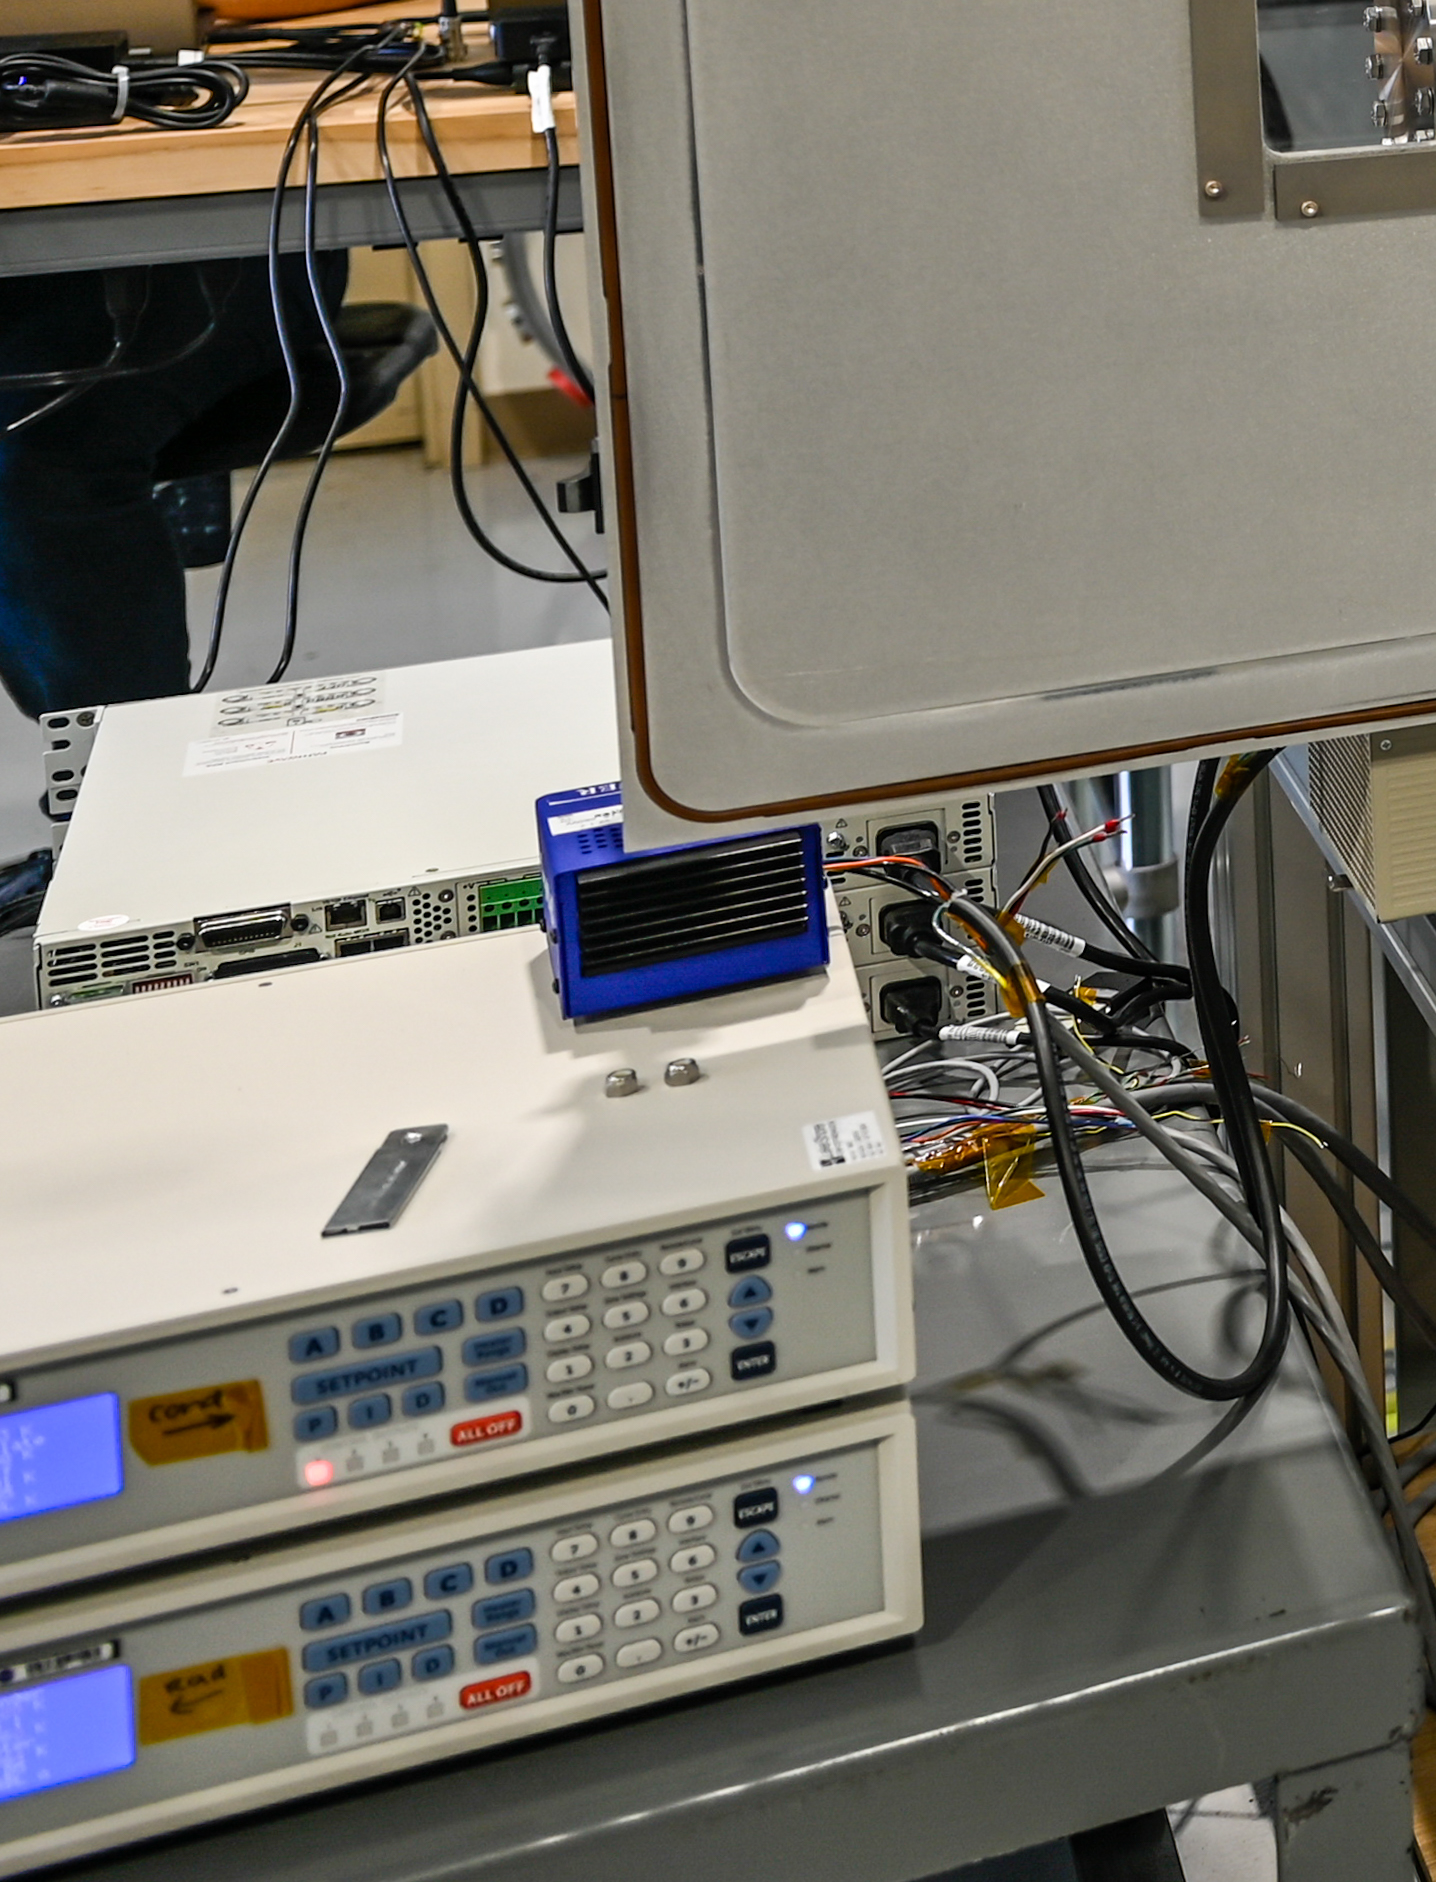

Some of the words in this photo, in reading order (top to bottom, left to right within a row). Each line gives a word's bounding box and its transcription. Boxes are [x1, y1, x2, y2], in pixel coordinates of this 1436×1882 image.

[729, 1247, 766, 1263] ESCAPE
[305, 1338, 323, 1356] A
[368, 1323, 385, 1342] B
[429, 1310, 447, 1328] C
[489, 1297, 508, 1315] D
[316, 1359, 417, 1394] SETPOINT
[737, 1355, 770, 1371] ENTER
[308, 1418, 321, 1432] P
[415, 1393, 430, 1409] D
[457, 1425, 485, 1442] ALL
[487, 1418, 517, 1436] OFF
[738, 1501, 775, 1518] ESCAPE
[317, 1606, 336, 1625] A
[379, 1590, 396, 1608] B
[440, 1574, 457, 1592] C
[499, 1559, 517, 1578] D
[745, 1609, 778, 1626] ENTER
[327, 1625, 428, 1663] SETPOINT
[319, 1686, 332, 1700] P
[425, 1659, 441, 1674] D
[467, 1689, 494, 1706] ALL
[496, 1680, 526, 1698] OFF
